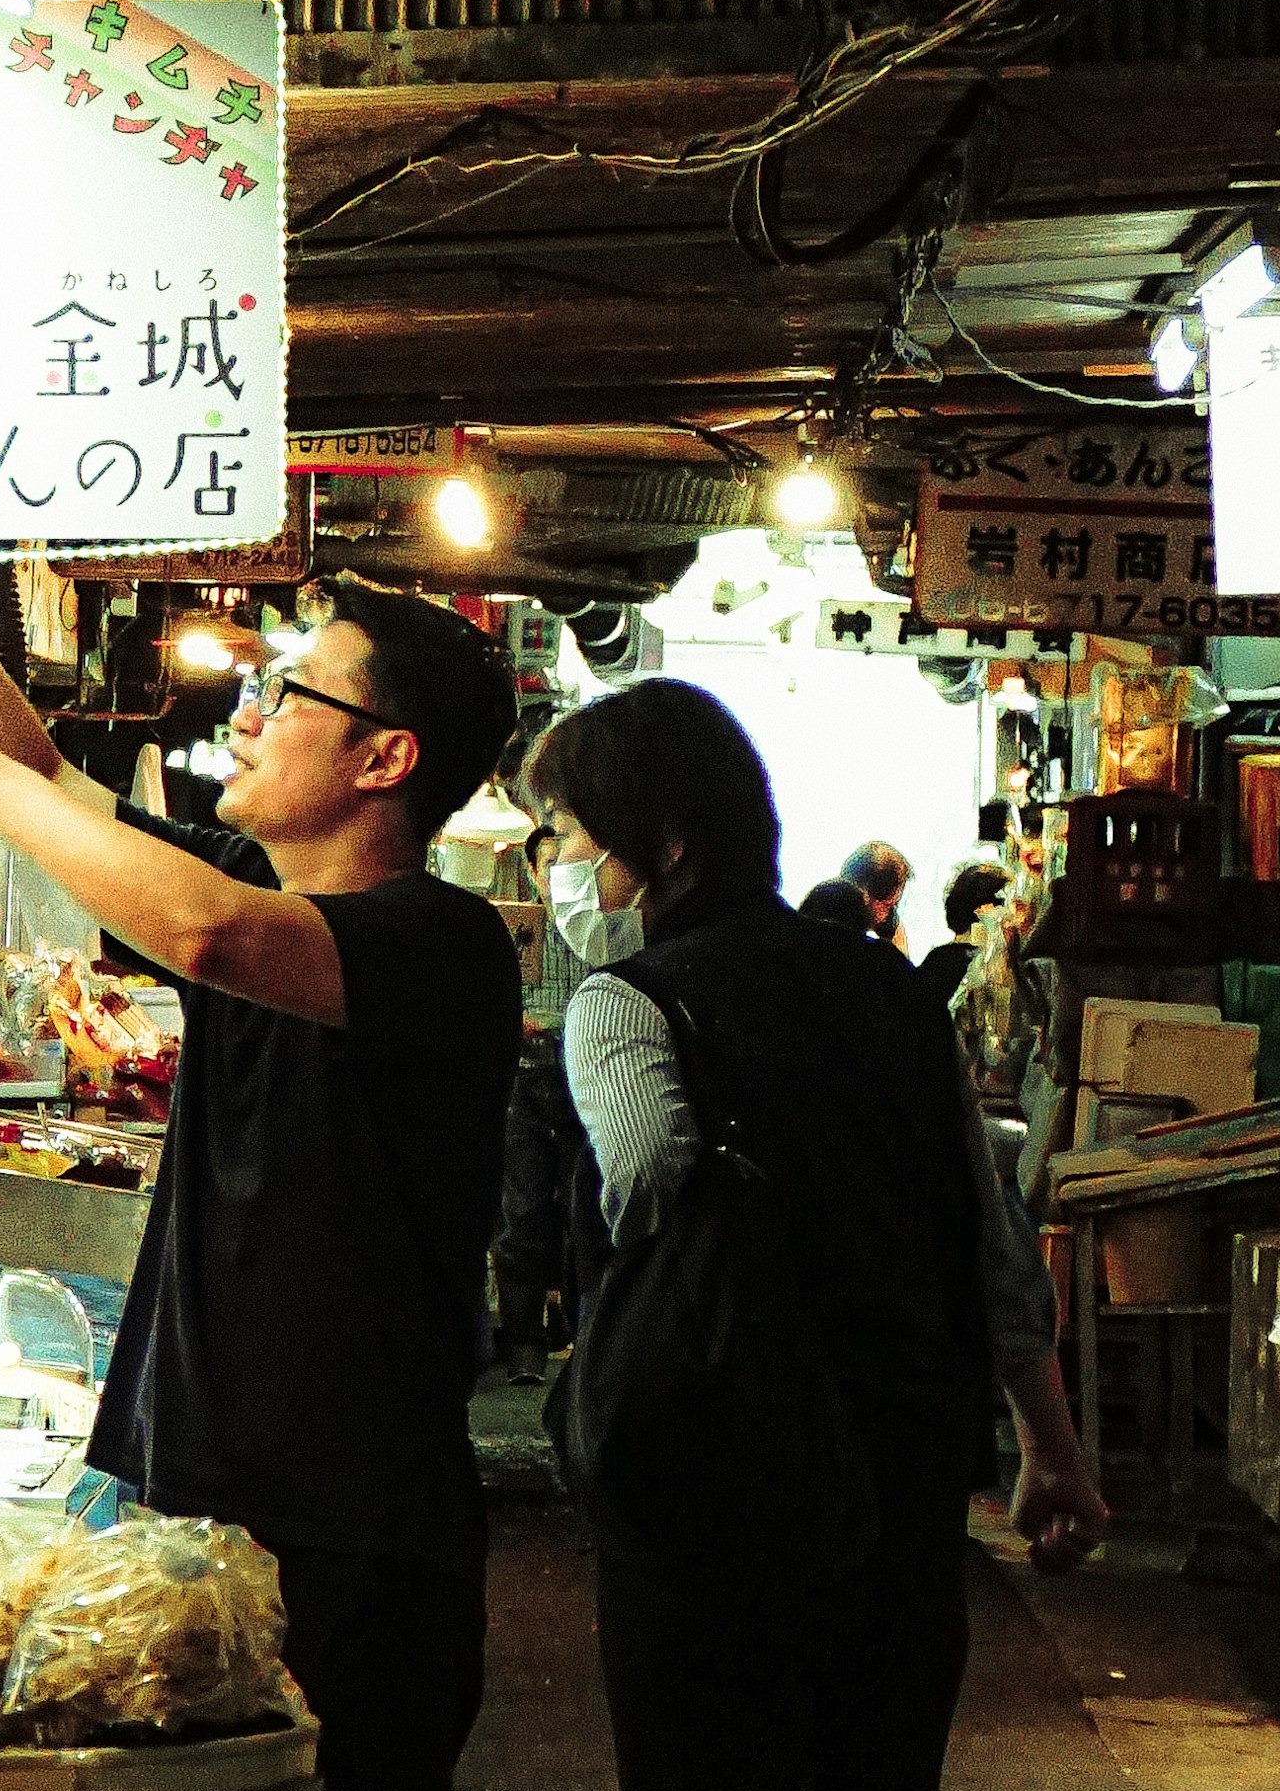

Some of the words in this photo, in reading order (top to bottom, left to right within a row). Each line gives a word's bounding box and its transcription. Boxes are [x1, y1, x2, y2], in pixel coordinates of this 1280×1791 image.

[85, 0, 264, 126] キムチ
[61, 268, 218, 292] かねしろ
[31, 298, 246, 400] 金城
